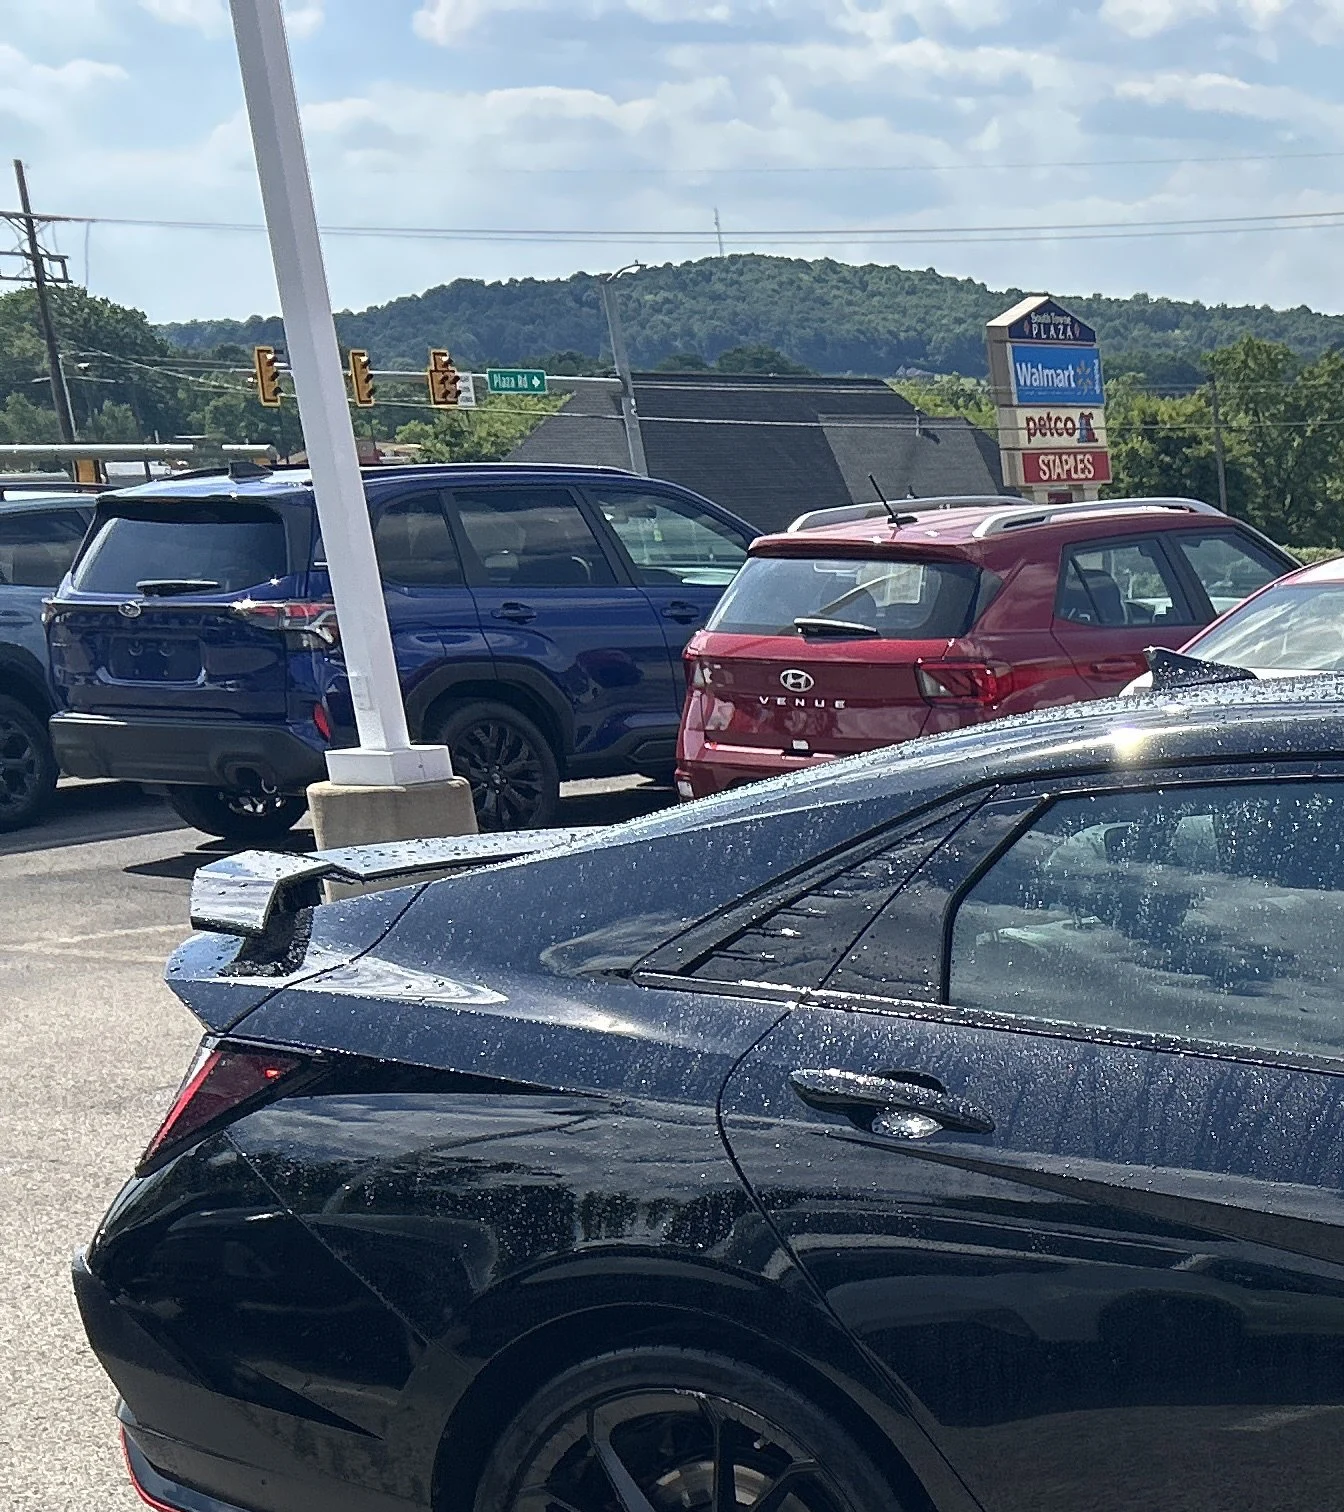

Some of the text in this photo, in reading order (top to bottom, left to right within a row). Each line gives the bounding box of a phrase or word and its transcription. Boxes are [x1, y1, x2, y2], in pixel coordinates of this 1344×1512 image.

[1032, 323, 1074, 340] PLAZA
[493, 373, 529, 389] Plaza Rd
[1015, 361, 1076, 388] Walmart
[1026, 412, 1077, 444] petco
[1039, 453, 1095, 481] STAPLES
[759, 696, 846, 709] VENUE
